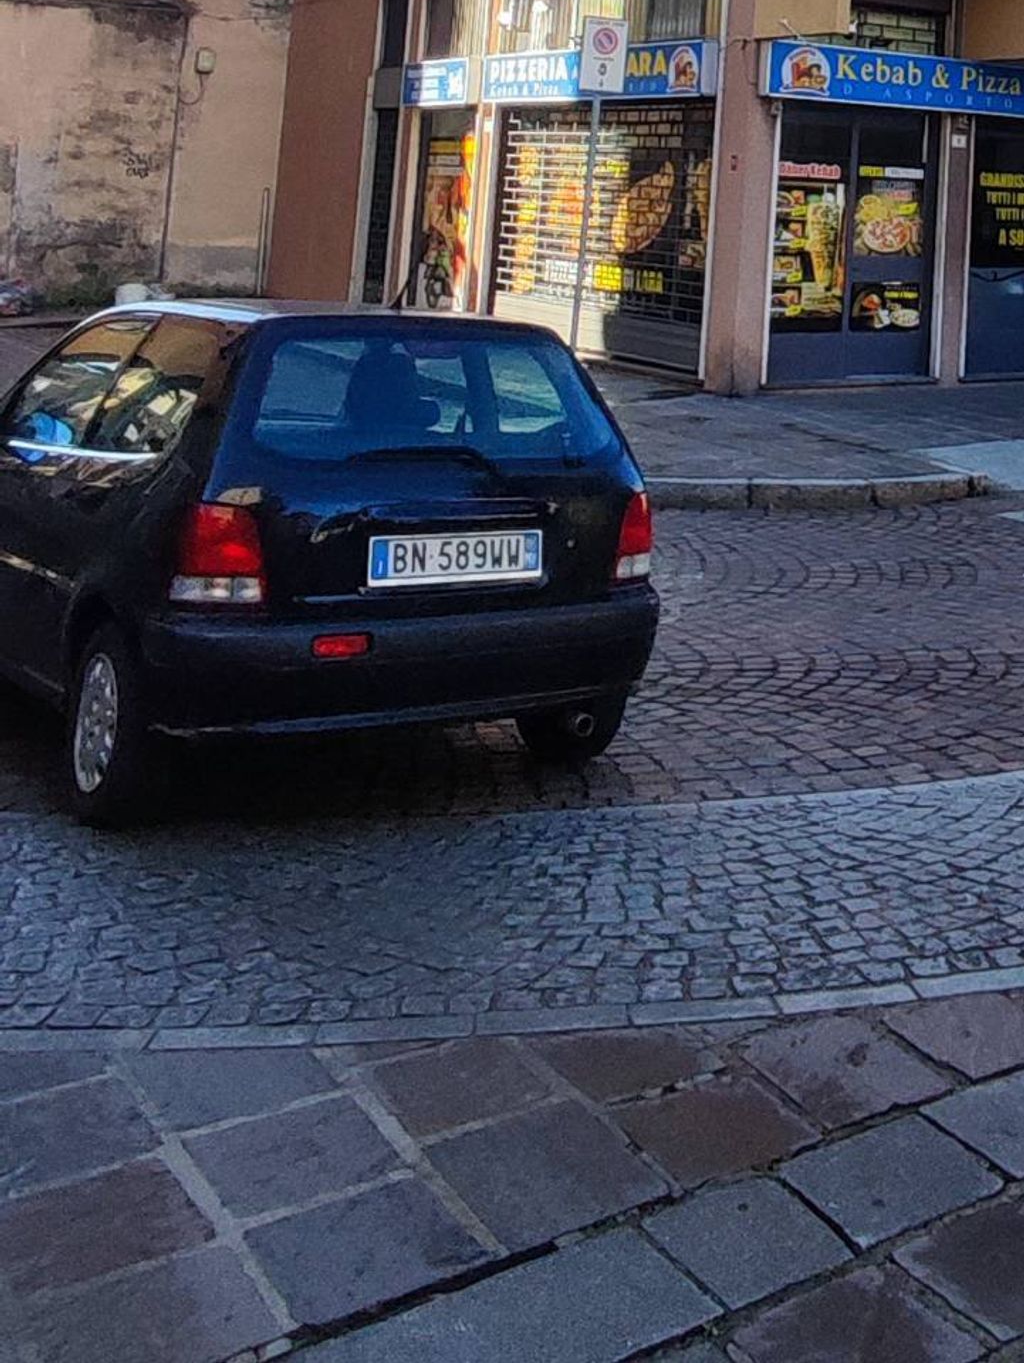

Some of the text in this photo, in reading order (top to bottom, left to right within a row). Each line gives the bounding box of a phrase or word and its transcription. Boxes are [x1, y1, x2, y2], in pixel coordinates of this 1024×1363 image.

[488, 56, 568, 83] PIZZERIA
[625, 49, 668, 77] ARA
[836, 52, 922, 87] Kebab
[931, 64, 951, 89] &
[959, 65, 1023, 96] Pizza
[986, 191, 1011, 204] TUTTI
[995, 207, 1020, 221] TUTTI
[998, 228, 1007, 246] A
[393, 538, 521, 573] BN 589WW
